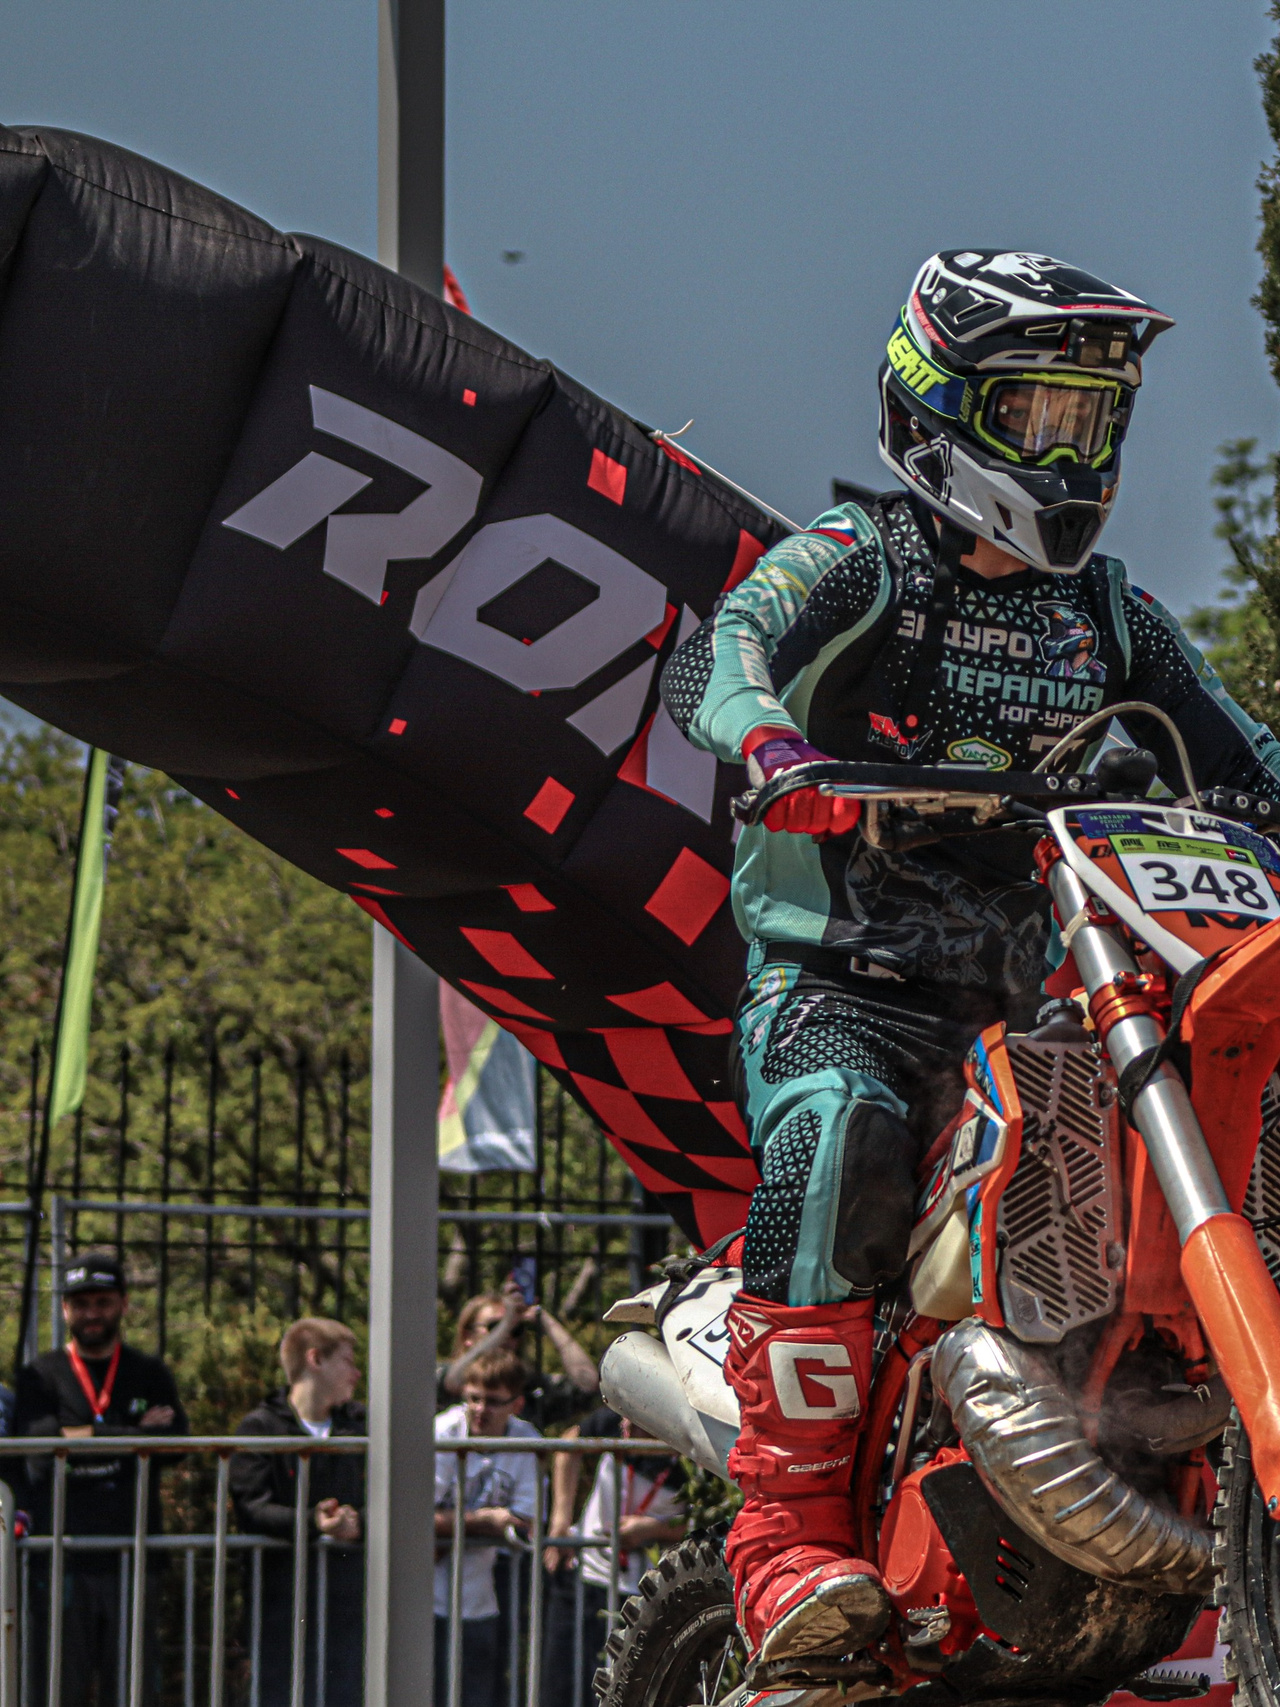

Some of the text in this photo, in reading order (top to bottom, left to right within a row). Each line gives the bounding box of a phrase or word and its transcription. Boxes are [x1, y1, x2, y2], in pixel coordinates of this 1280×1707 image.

[887, 326, 951, 396] LEATT
[941, 660, 1105, 712] ТЕРАПИЯ
[998, 703, 1092, 730] ЮГ-УРА
[1139, 860, 1269, 910] 348
